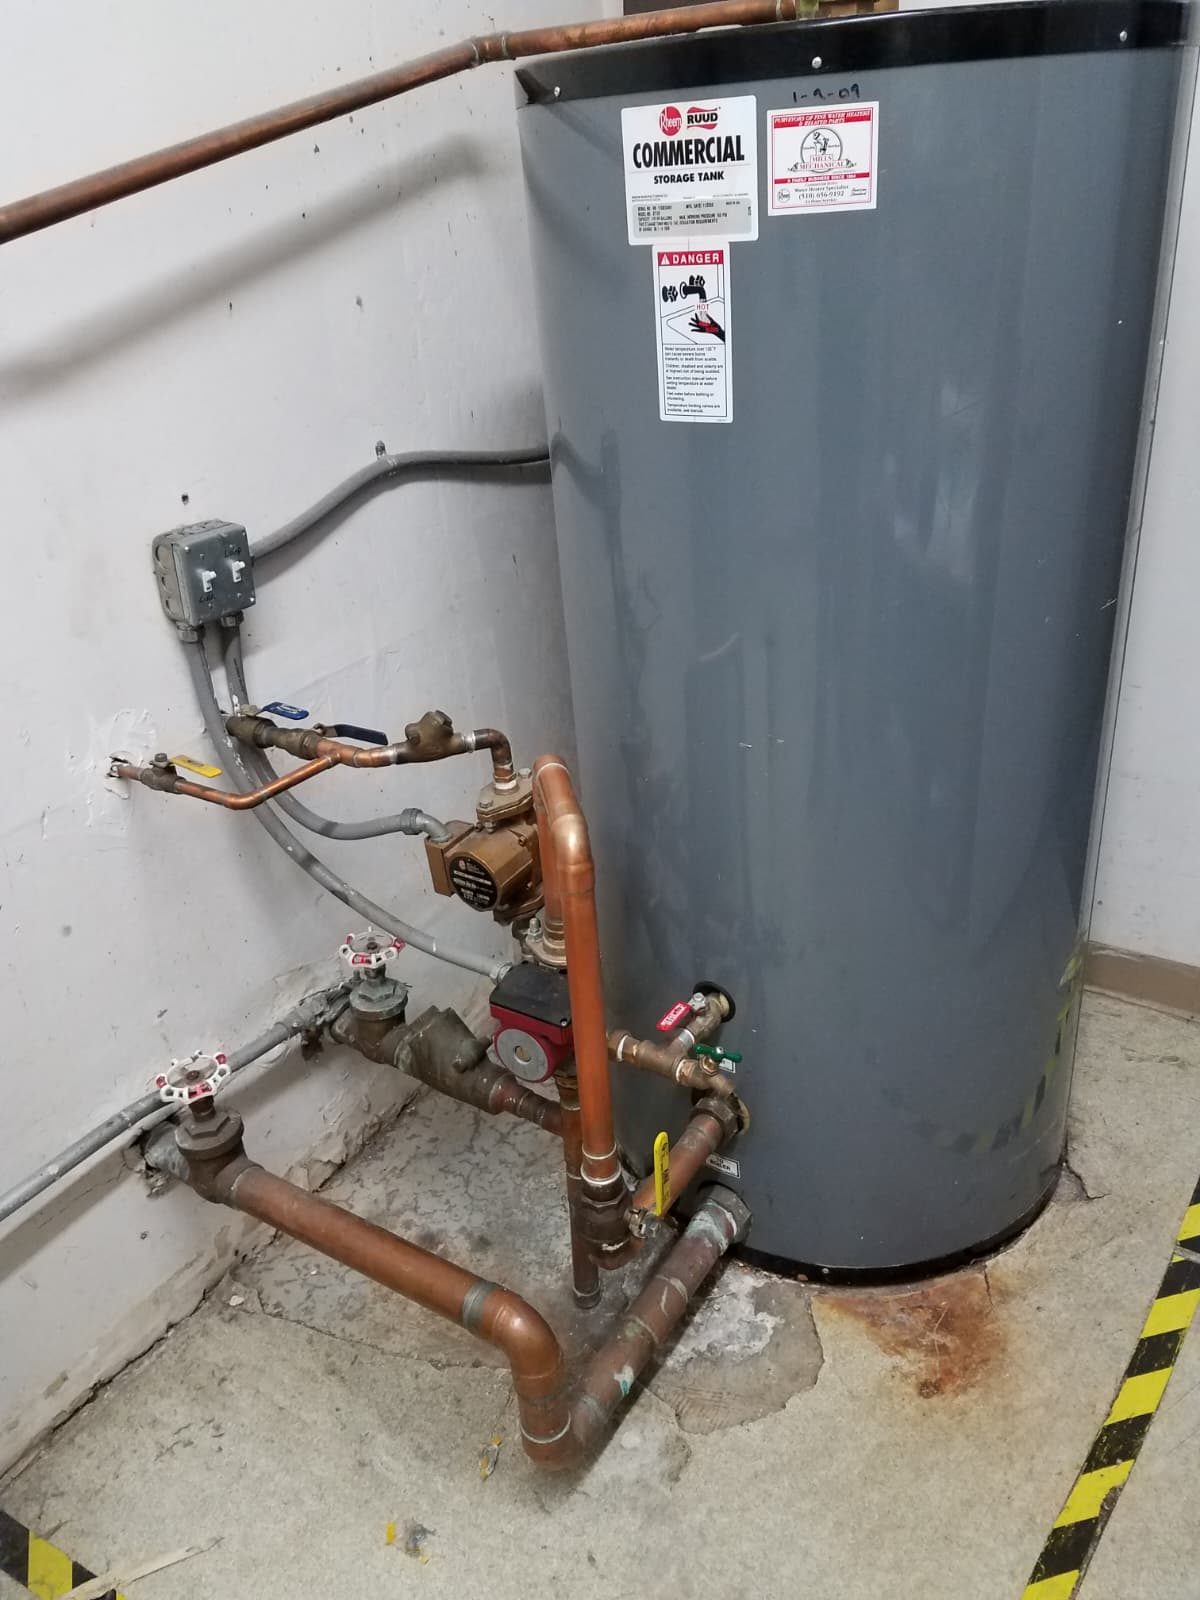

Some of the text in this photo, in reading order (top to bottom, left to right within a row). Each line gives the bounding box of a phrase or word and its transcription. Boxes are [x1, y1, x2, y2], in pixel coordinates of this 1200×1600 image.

[687, 112, 718, 124] RUUD
[633, 135, 745, 168] COMMERCIAL
[799, 161, 844, 170] MECHANICAL
[654, 171, 724, 184] STORAGE TANK
[672, 253, 720, 265] DANGER
